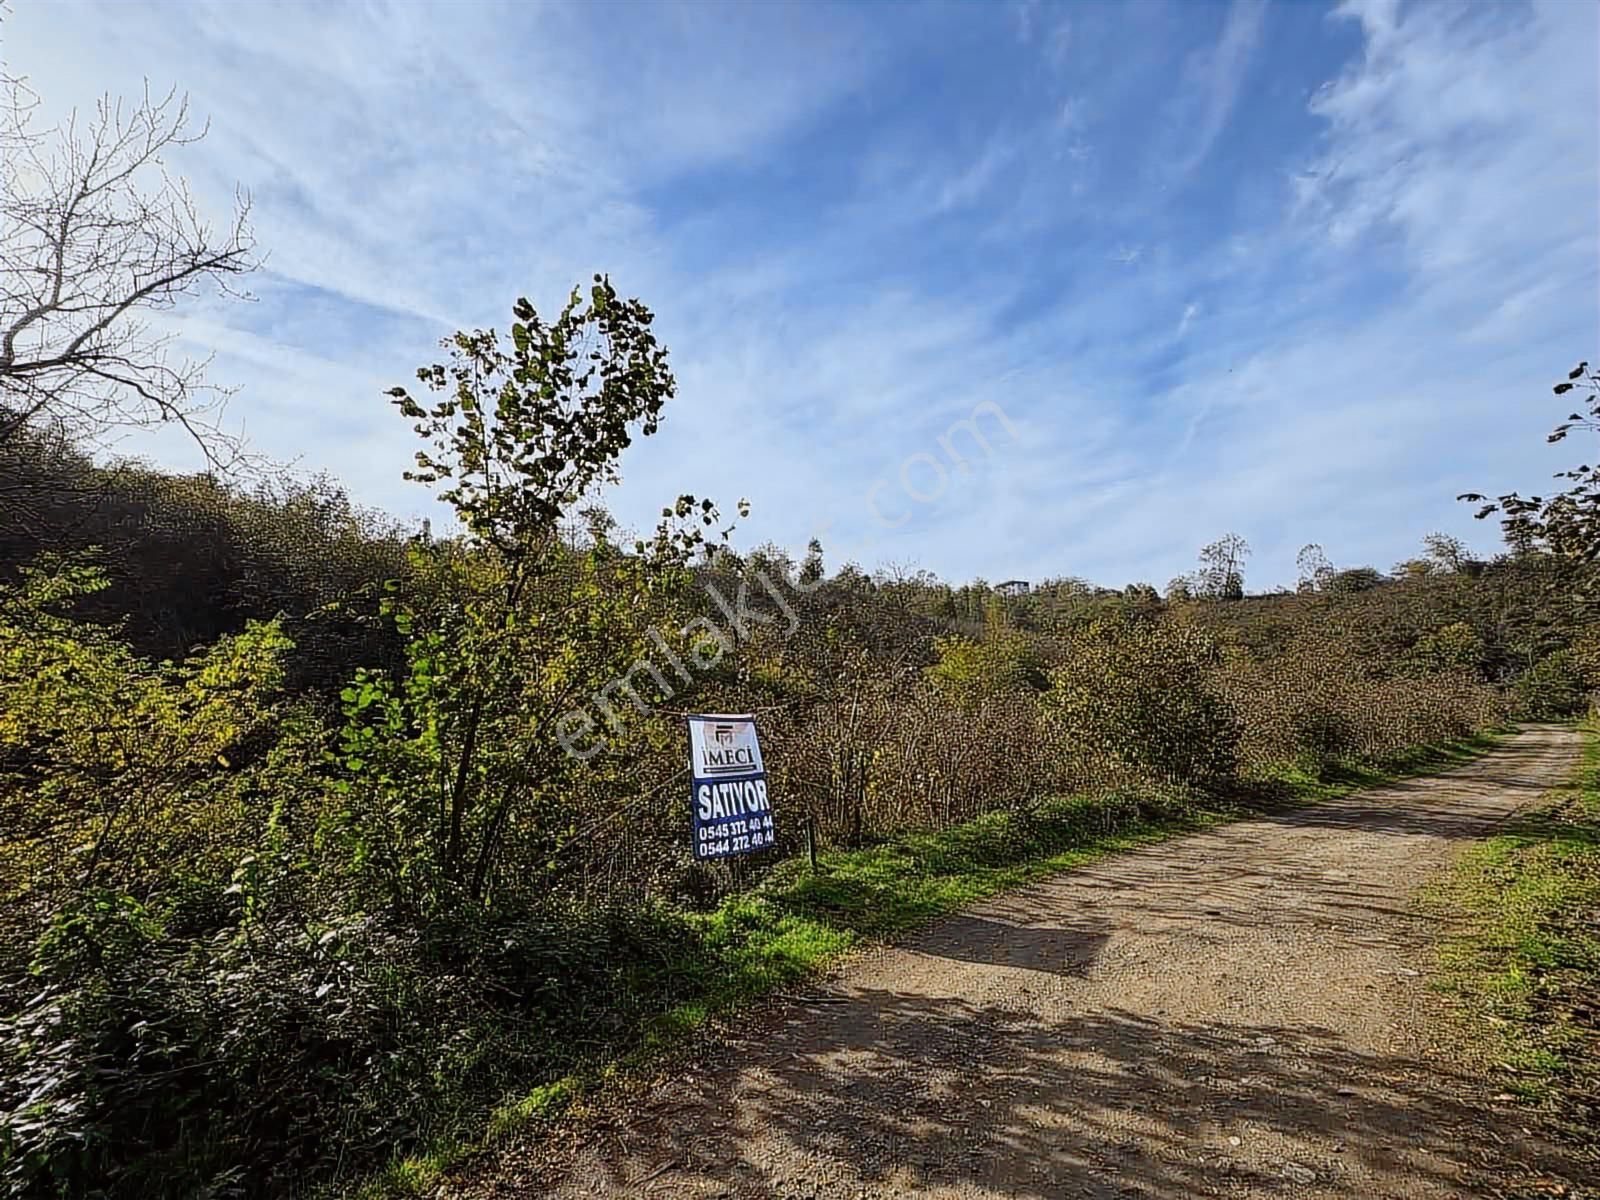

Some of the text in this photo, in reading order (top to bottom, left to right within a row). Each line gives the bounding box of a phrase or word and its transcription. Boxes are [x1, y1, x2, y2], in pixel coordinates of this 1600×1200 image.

[698, 780, 770, 820] SATIYOR
[699, 823, 729, 841] 0545
[730, 820, 748, 835] 372
[749, 817, 761, 831] 40
[699, 839, 730, 857] 0544
[732, 835, 750, 851] 272
[751, 832, 764, 846] 40
